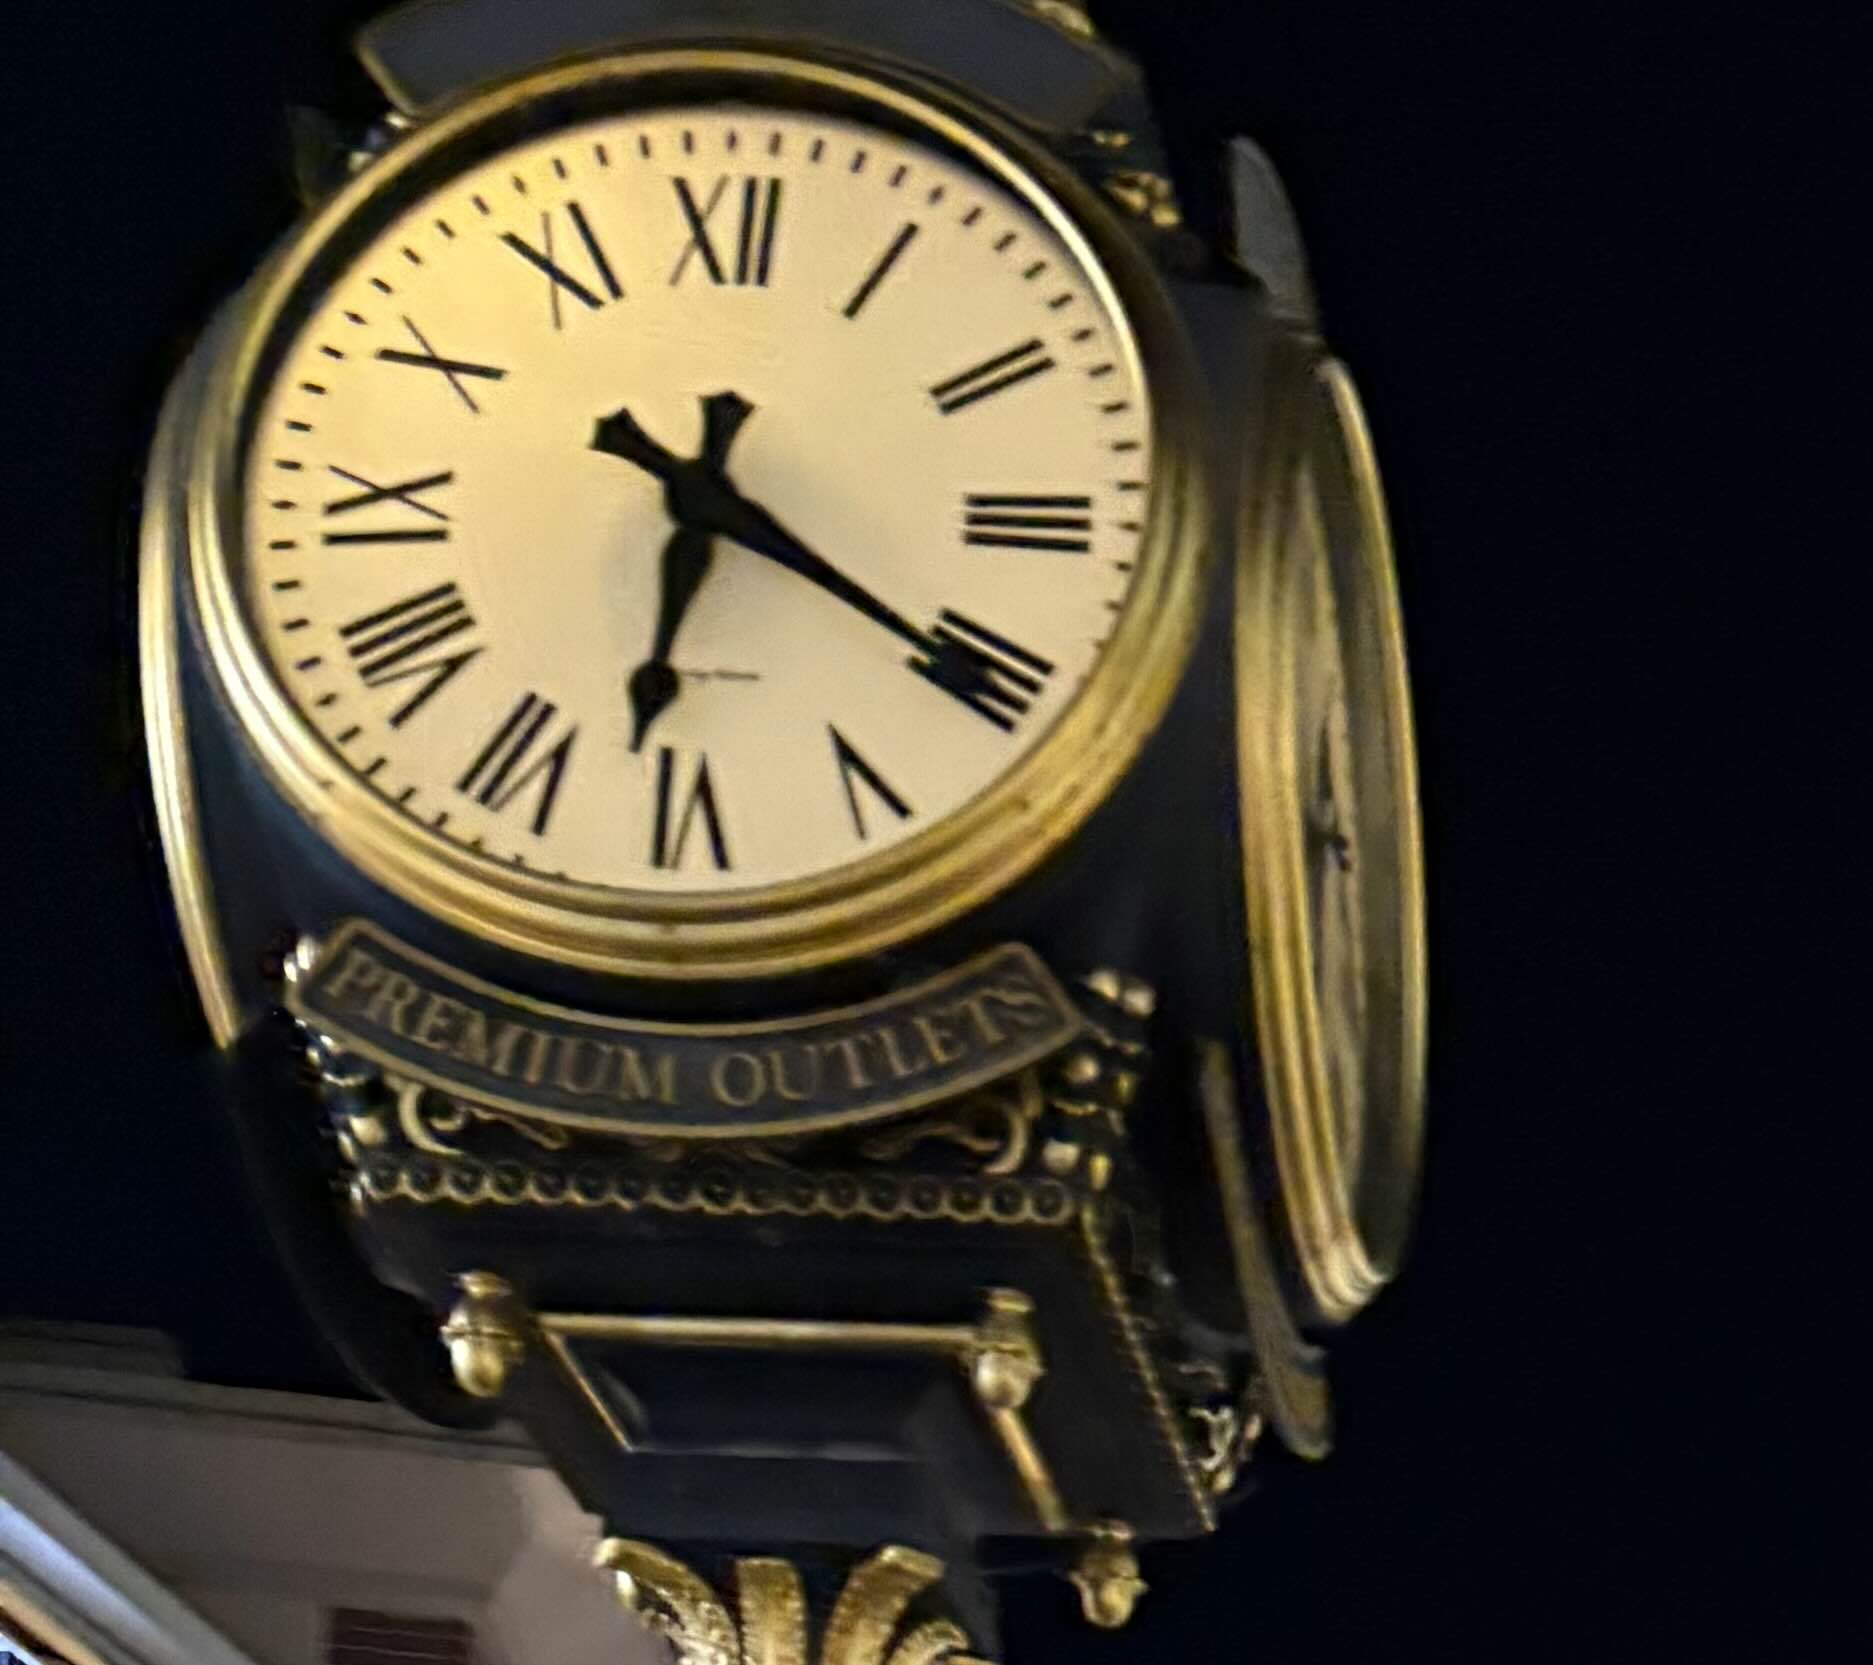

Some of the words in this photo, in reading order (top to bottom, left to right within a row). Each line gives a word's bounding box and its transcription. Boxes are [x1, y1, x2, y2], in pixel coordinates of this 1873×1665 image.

[500, 200, 625, 330] XI
[669, 175, 784, 288] XII
[374, 315, 507, 413] X
[930, 337, 1058, 416] II
[320, 465, 455, 547] IX
[961, 493, 1094, 554] III
[337, 581, 484, 732] VIII
[455, 691, 579, 838] VII
[649, 745, 733, 872] VI
[323, 946, 679, 1105] PREMIUM
[708, 974, 1050, 1107] OUTLETS
